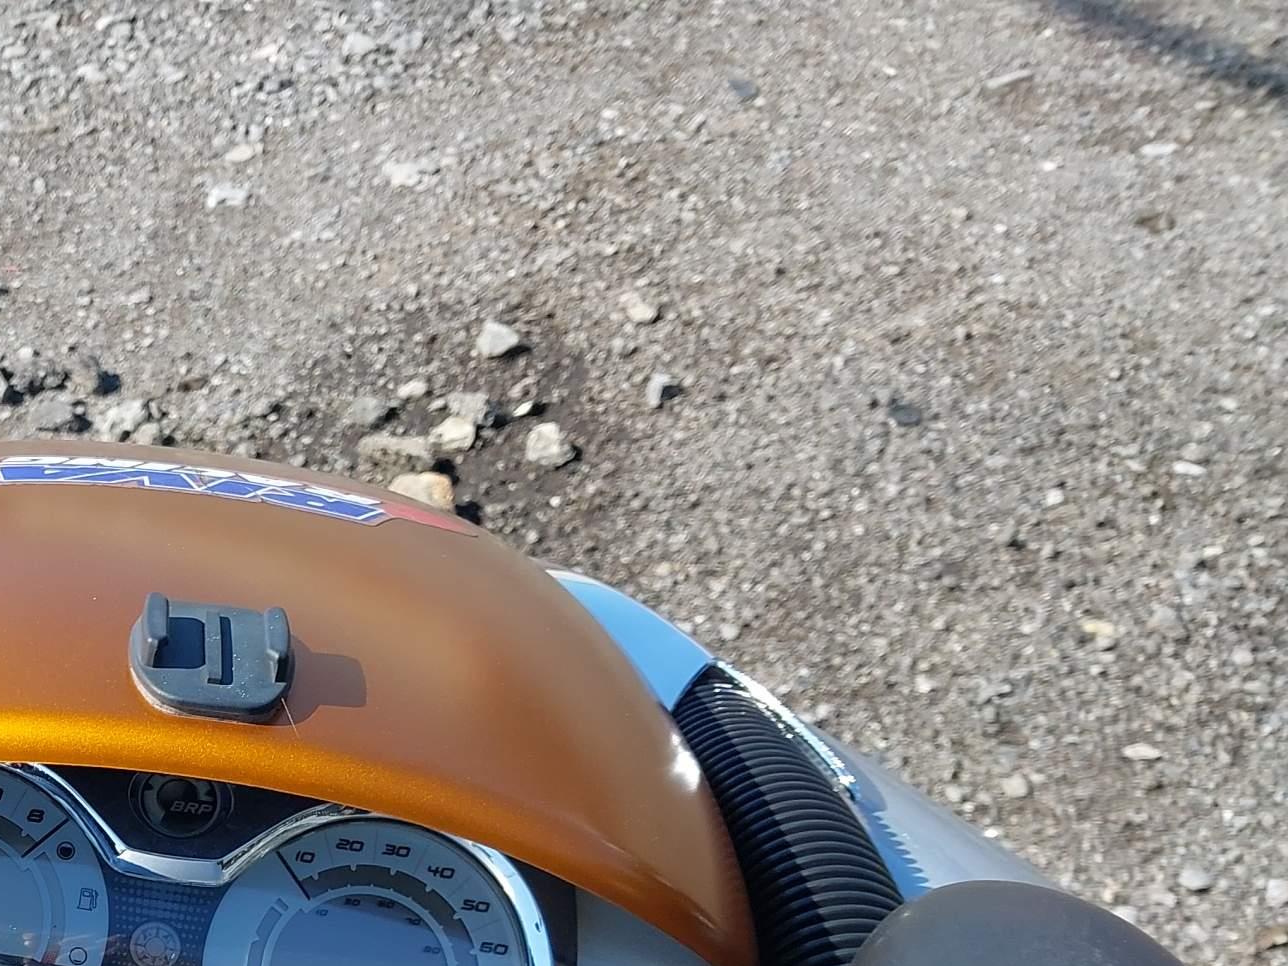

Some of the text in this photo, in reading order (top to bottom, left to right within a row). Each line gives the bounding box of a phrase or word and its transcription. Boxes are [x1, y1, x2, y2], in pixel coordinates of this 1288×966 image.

[170, 800, 213, 815] BRP
[26, 808, 45, 824] 8
[335, 838, 365, 852] 20
[381, 843, 411, 858] 30
[295, 850, 316, 864] 10
[427, 865, 455, 879] 40
[461, 899, 491, 913] 50
[479, 941, 509, 956] 60
